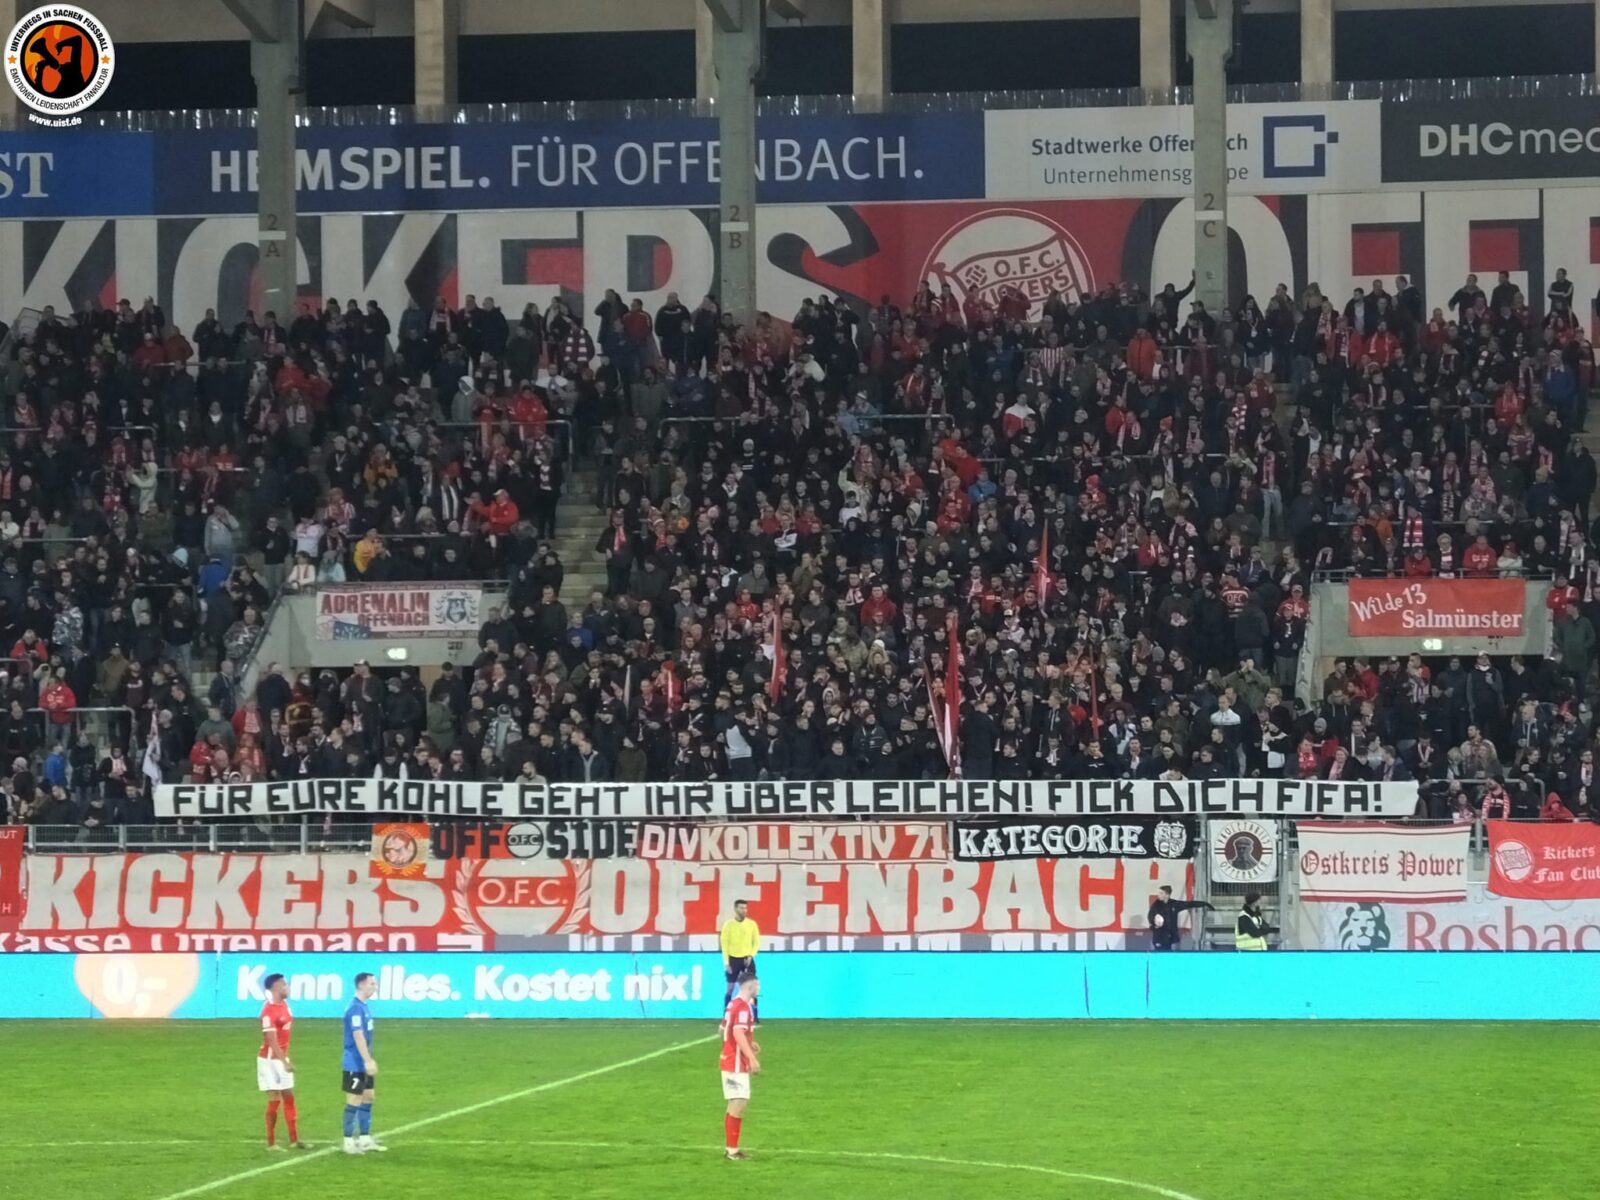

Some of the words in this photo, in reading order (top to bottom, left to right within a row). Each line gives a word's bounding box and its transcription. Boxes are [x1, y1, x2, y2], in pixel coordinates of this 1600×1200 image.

[1031, 136, 1143, 156] Stadtwerke
[211, 145, 490, 192] HMSPIEL.
[511, 136, 598, 187] FÜR
[1202, 193, 1215, 210] 2
[267, 214, 278, 230] 2
[729, 204, 740, 222] 2
[729, 232, 742, 249] B
[1202, 221, 1216, 238] C
[265, 241, 281, 258] A
[993, 250, 1061, 278] O.F.C.
[321, 592, 430, 614] ADRENALIN
[1350, 592, 1403, 622] Wilde
[1402, 583, 1427, 605] 13
[357, 612, 430, 627] OFFENBACH
[1402, 608, 1522, 629] Salmünster
[173, 784, 252, 815] FÜR
[266, 779, 367, 813] EURE
[378, 779, 504, 816] KOHLE
[518, 784, 630, 815] GEHT
[645, 783, 714, 814] IHR
[725, 783, 835, 814] ÜBER
[845, 781, 1033, 813] LEICHEN!
[1048, 781, 1135, 813] FICK
[1153, 779, 1263, 813] DICH
[1276, 781, 1383, 813] FIFA!
[507, 833, 537, 846] O.F.C.
[546, 820, 638, 859] SIDE
[700, 825, 895, 860] KOLLEKTIV
[904, 826, 946, 859] 71
[958, 824, 1147, 861] KATEGORIE
[1301, 850, 1389, 876] Ostkreis
[1396, 850, 1465, 881] Power
[1533, 867, 1565, 884] Fan
[21, 853, 447, 930] KICKERS
[477, 877, 568, 905] O.F.C.
[589, 856, 1193, 935] OFFENBACH
[238, 964, 342, 1002] Knn
[474, 964, 611, 1002] Kostet
[623, 964, 703, 1001] nix!
